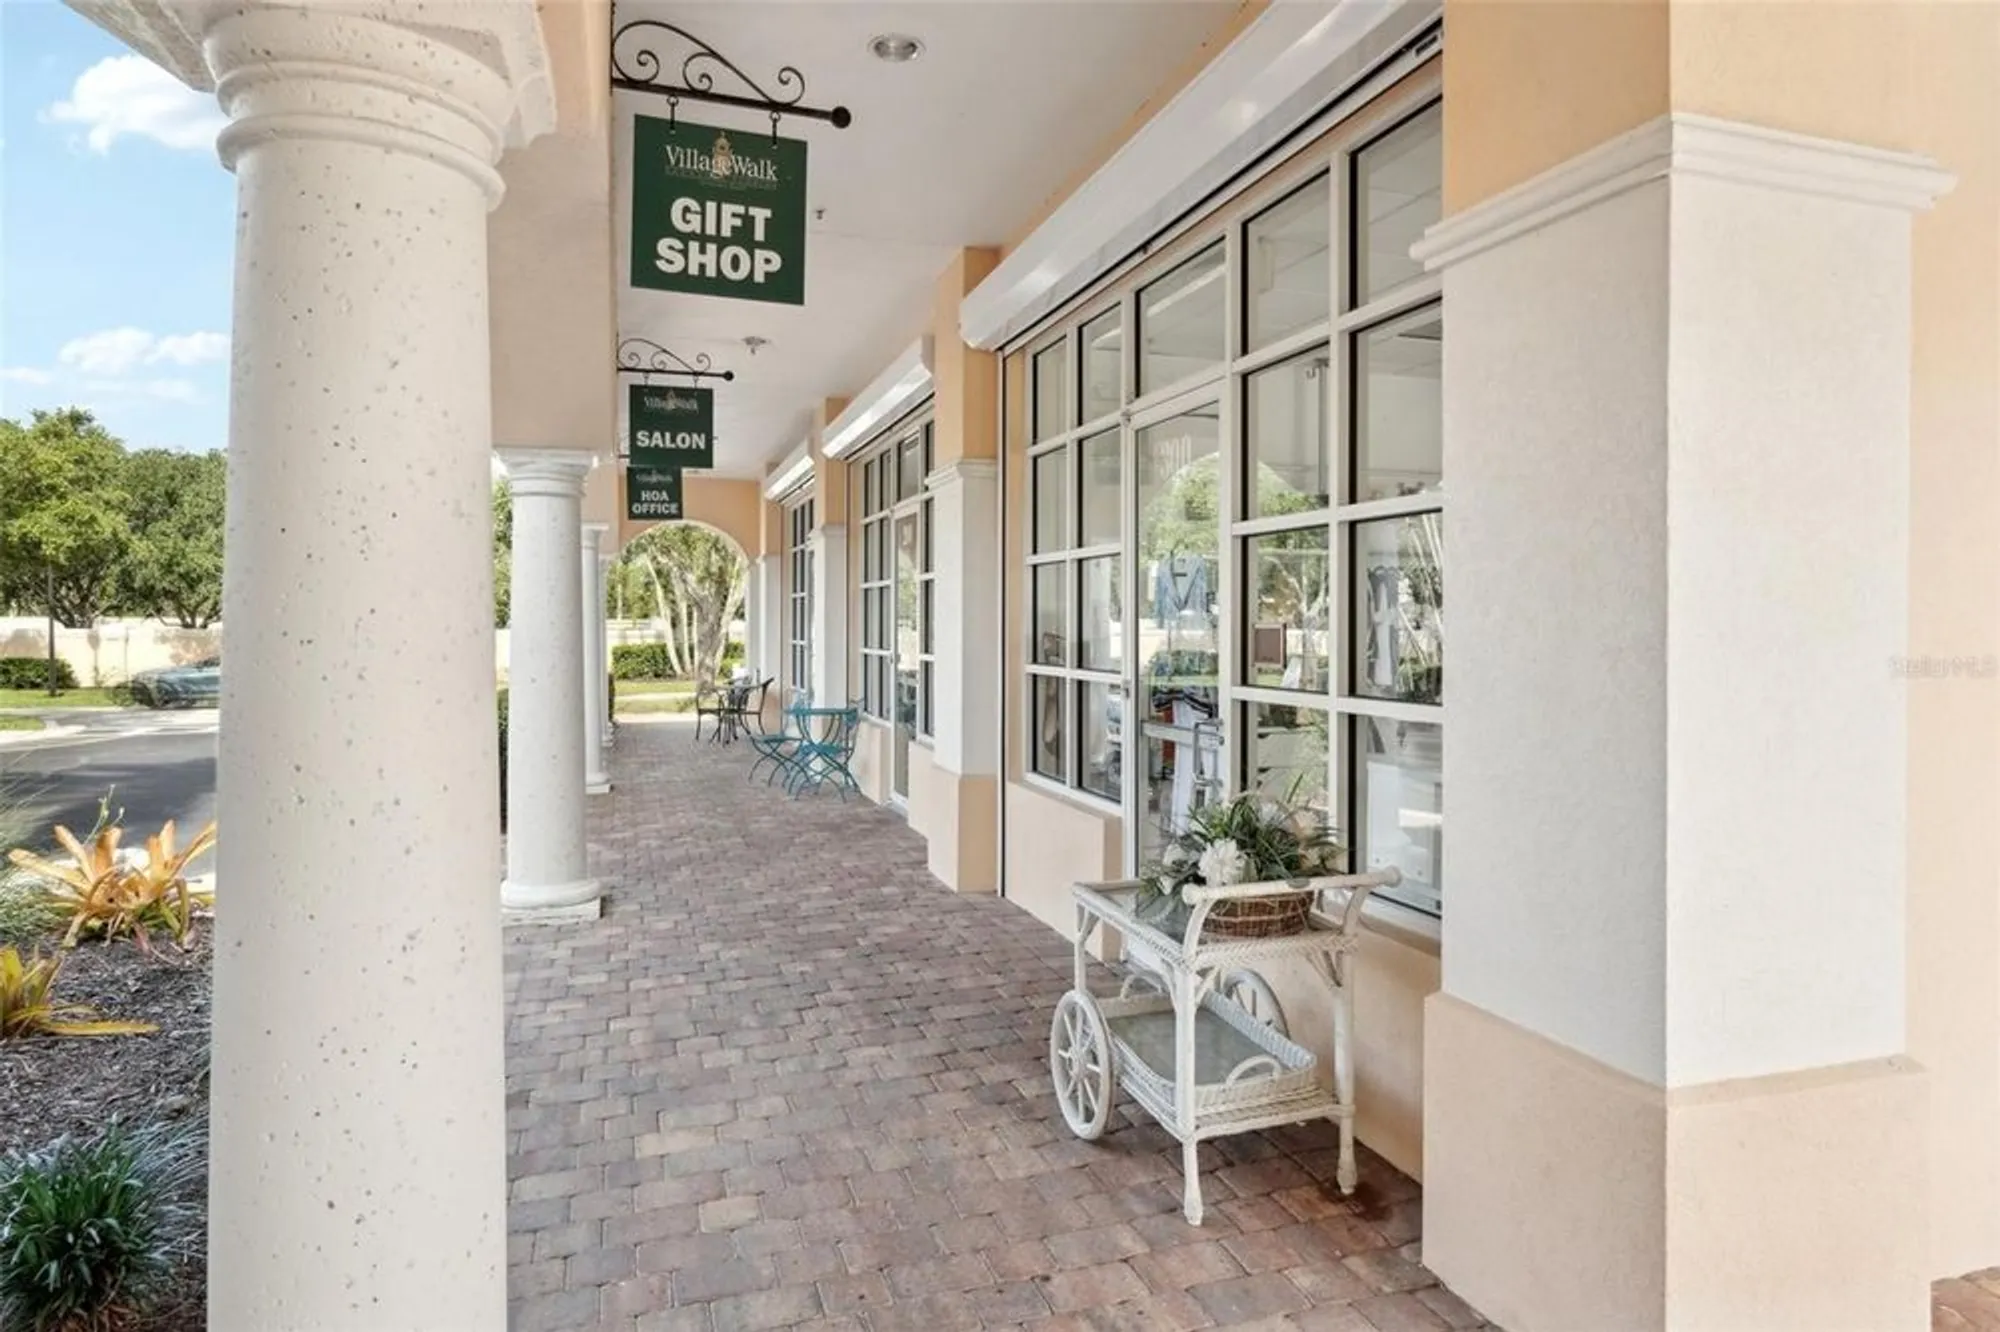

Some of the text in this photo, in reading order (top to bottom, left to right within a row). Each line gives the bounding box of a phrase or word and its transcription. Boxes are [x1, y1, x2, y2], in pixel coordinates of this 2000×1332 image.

[670, 196, 772, 242] GIFT
[655, 237, 782, 284] SHOP
[636, 430, 706, 450] SALON
[641, 490, 669, 501] HOA
[632, 502, 678, 514] OFFICE
